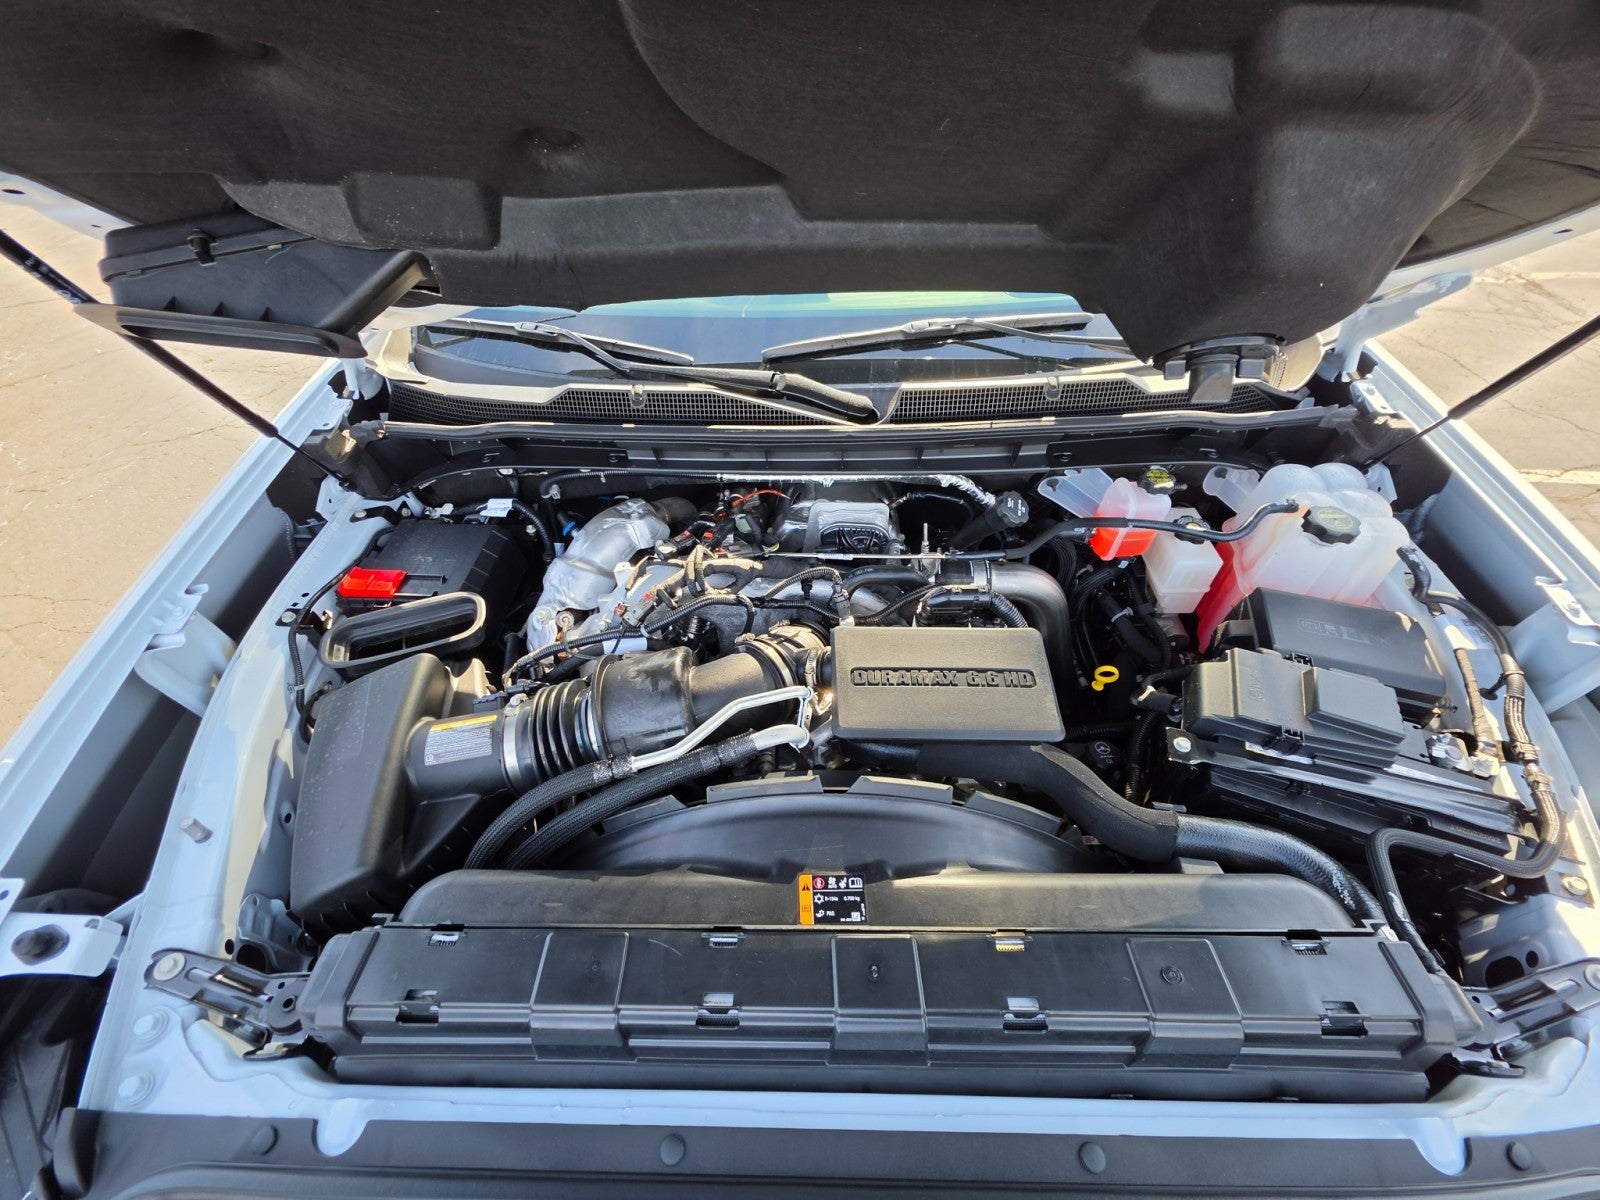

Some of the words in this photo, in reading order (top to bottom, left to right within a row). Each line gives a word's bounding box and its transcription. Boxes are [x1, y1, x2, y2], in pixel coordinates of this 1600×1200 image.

[852, 669, 958, 686] DURAMAX
[966, 670, 1000, 687] 6.6
[1005, 671, 1035, 688] HD
